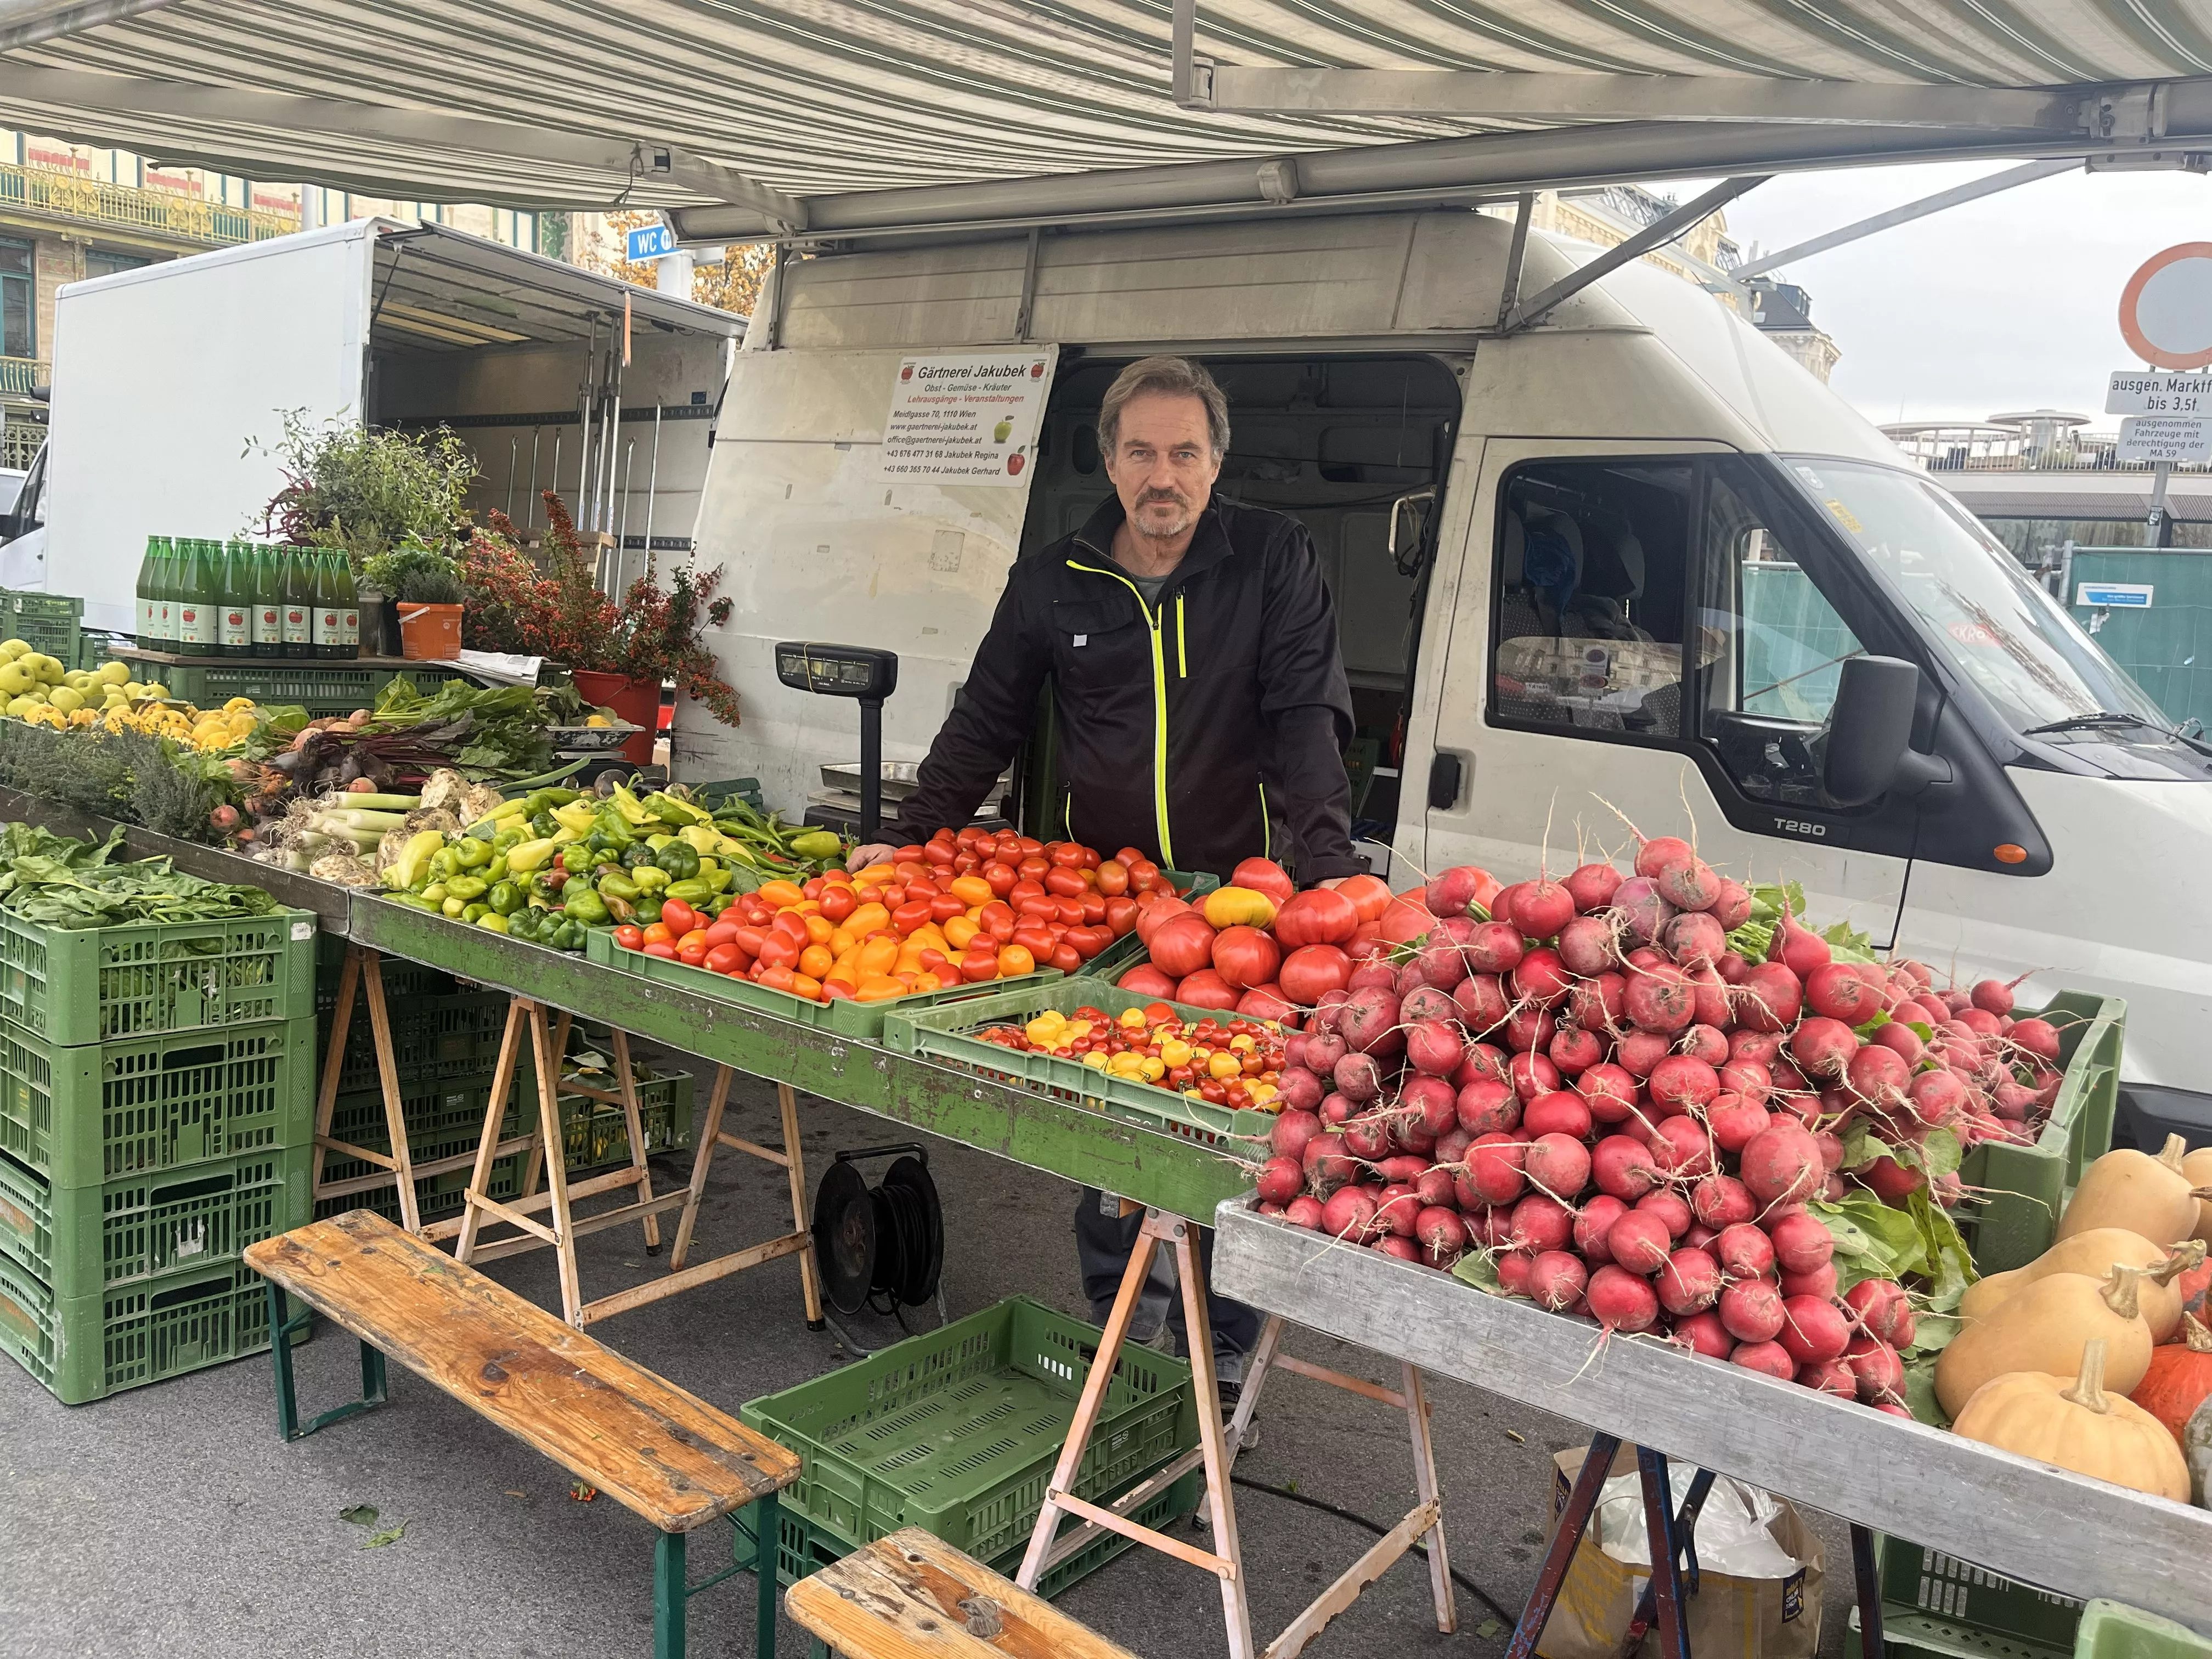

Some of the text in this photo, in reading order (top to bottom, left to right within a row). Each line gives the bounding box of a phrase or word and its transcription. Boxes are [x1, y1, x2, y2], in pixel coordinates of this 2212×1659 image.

[637, 232, 657, 254] WC
[918, 364, 1027, 379] Gärtnerei Jakubek
[947, 383, 977, 392] Gemüse
[983, 383, 1012, 391] Kräuter
[2112, 380, 2162, 394] ausgen.
[907, 395, 957, 404] Lehrausgänge
[964, 394, 1024, 404] Veranstaltungen
[2147, 396, 2197, 411] bis 3,5t
[893, 410, 930, 419] Meidlgasse
[932, 410, 940, 419] 70,
[890, 423, 978, 432] www.gaertnerei-jakubek.at
[2136, 420, 2202, 428] ausgenommen
[2135, 428, 2199, 439] Fahrzeuge mit
[887, 436, 982, 445] office@gaertnerei-jakubek.at
[944, 450, 973, 459] Jakubek
[974, 451, 998, 461] Regina
[2165, 449, 2177, 458] 59
[941, 466, 970, 475] Jakubek
[972, 467, 1001, 475] Gerhard
[1774, 817, 1826, 836] T280
